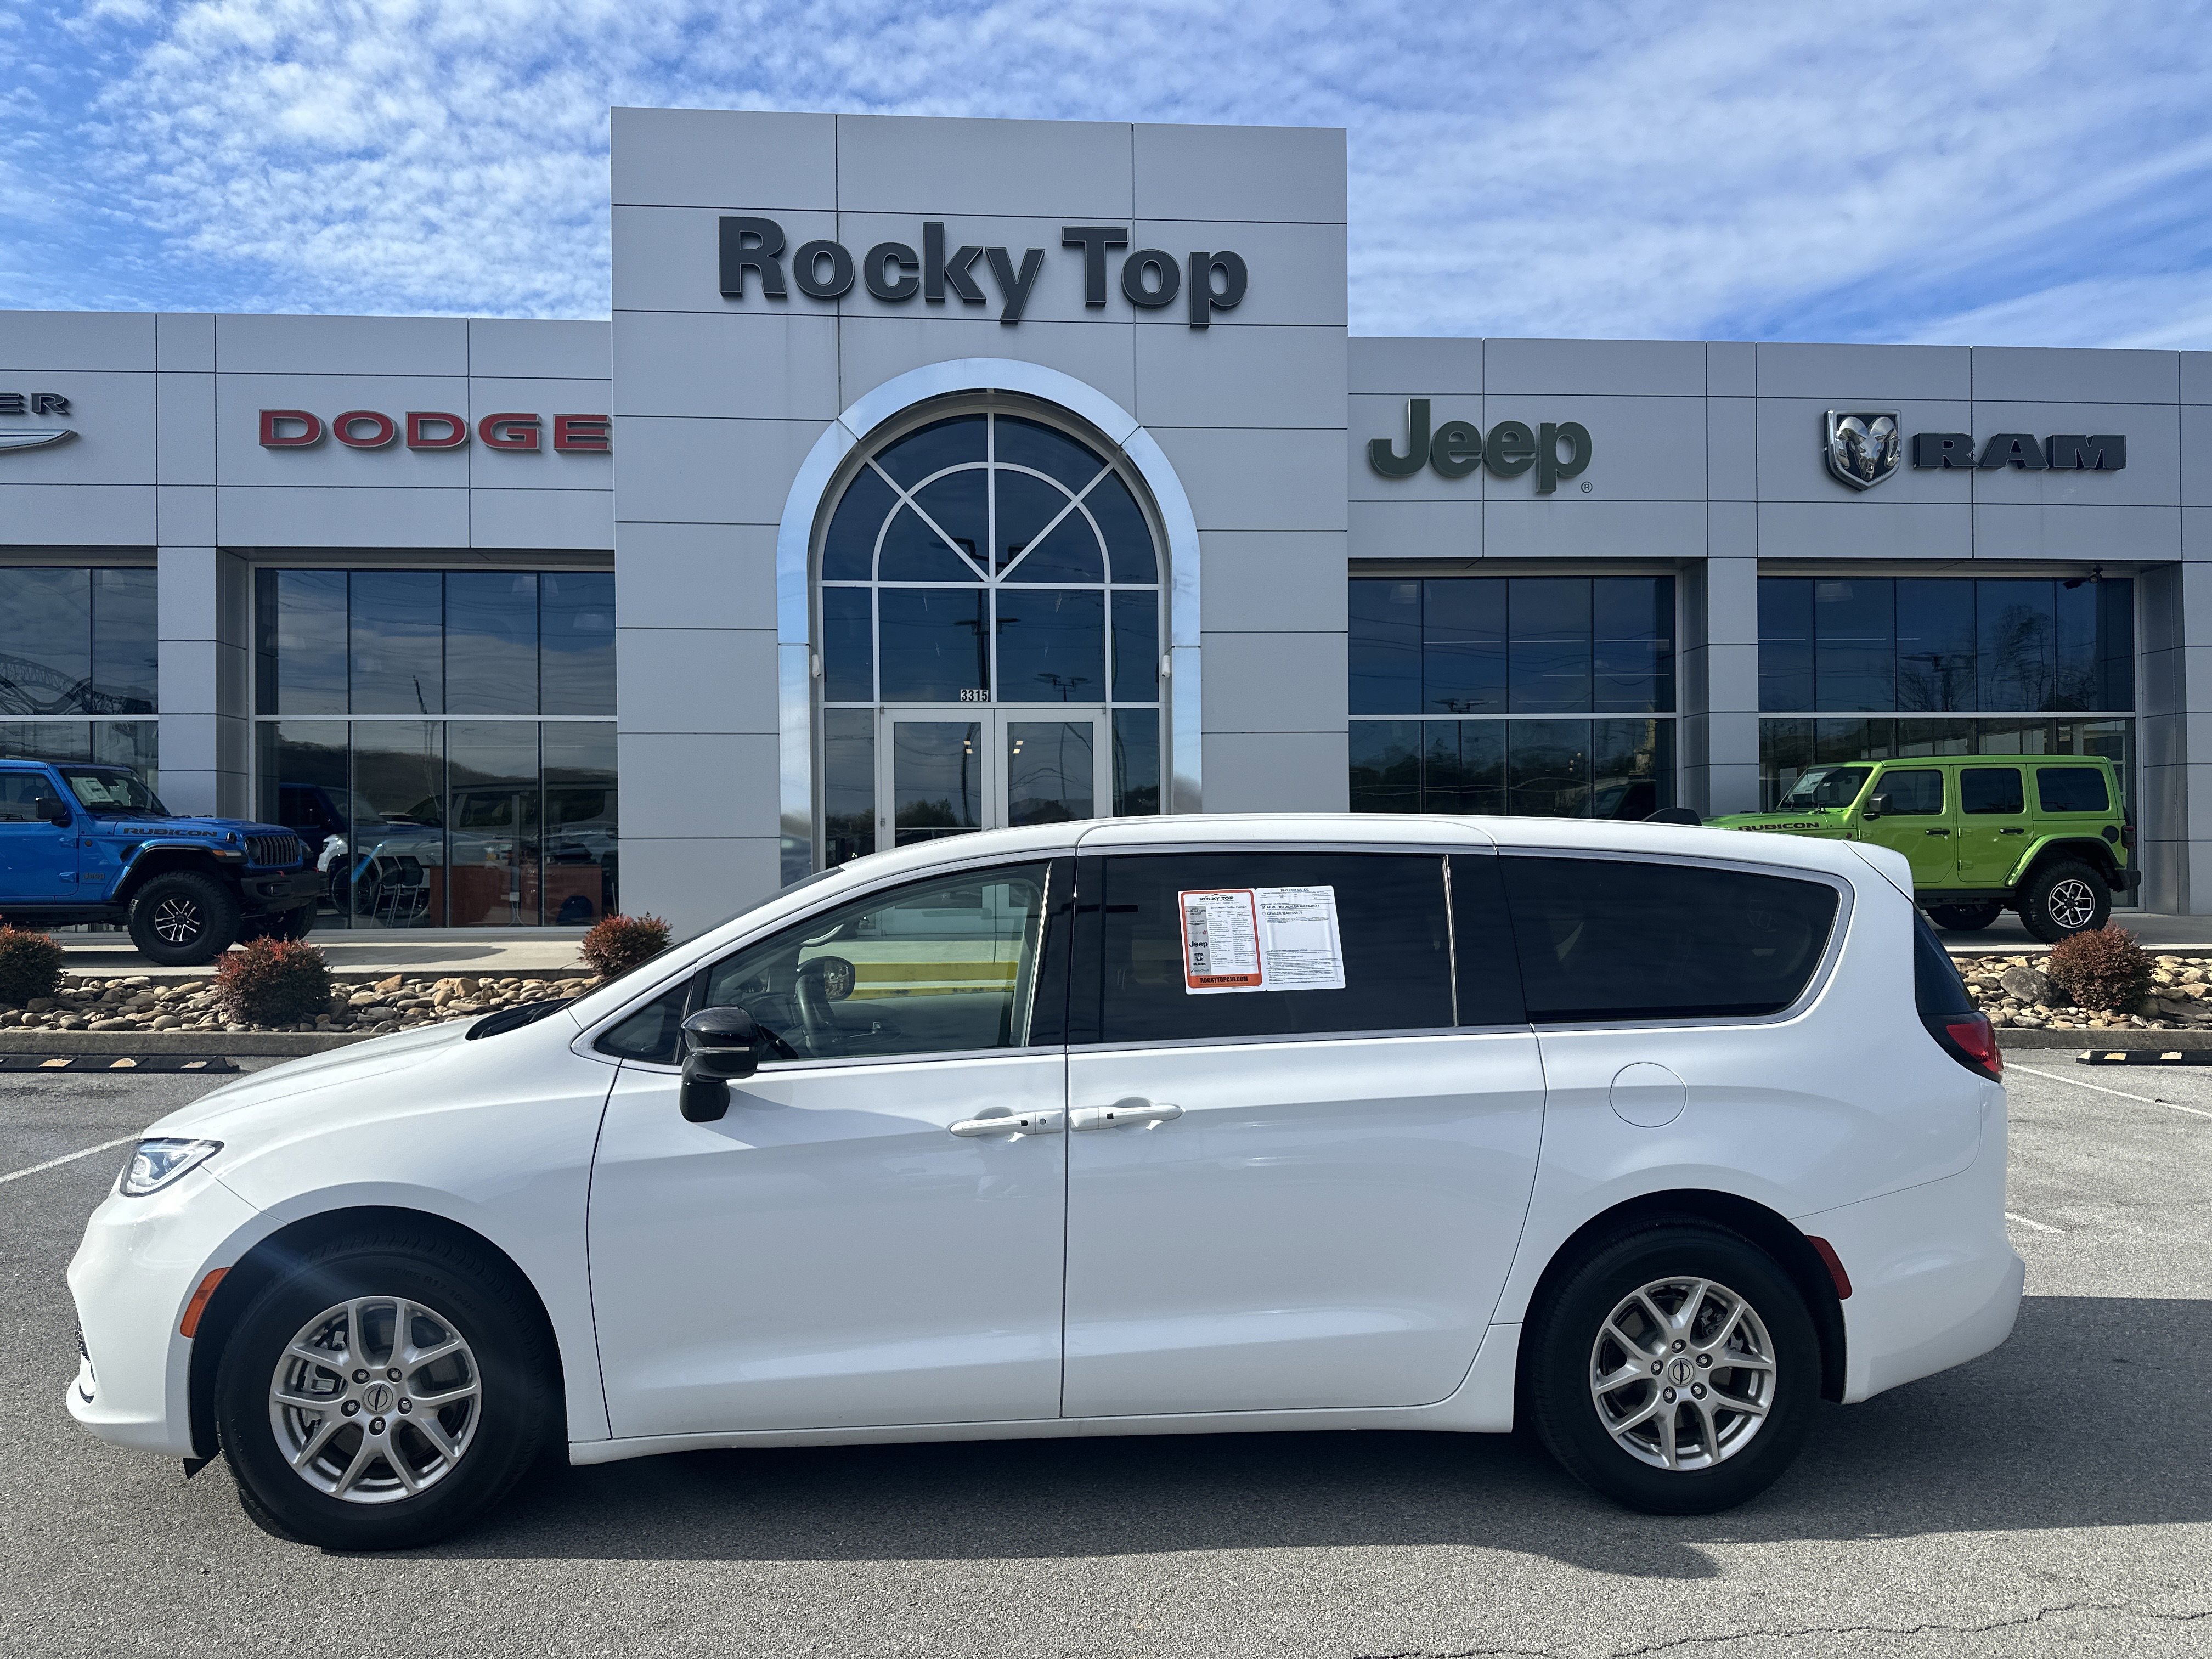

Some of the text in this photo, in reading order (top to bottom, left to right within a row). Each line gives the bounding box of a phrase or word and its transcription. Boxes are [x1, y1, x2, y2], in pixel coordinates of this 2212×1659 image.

[718, 216, 1249, 329] Rocky Top
[259, 409, 612, 454] DODGE
[1369, 399, 1592, 493] Jeep
[1912, 432, 2126, 470] RAM
[961, 690, 988, 701] 3315
[123, 828, 217, 837] RUBICON
[1737, 822, 1819, 831] RUBICON
